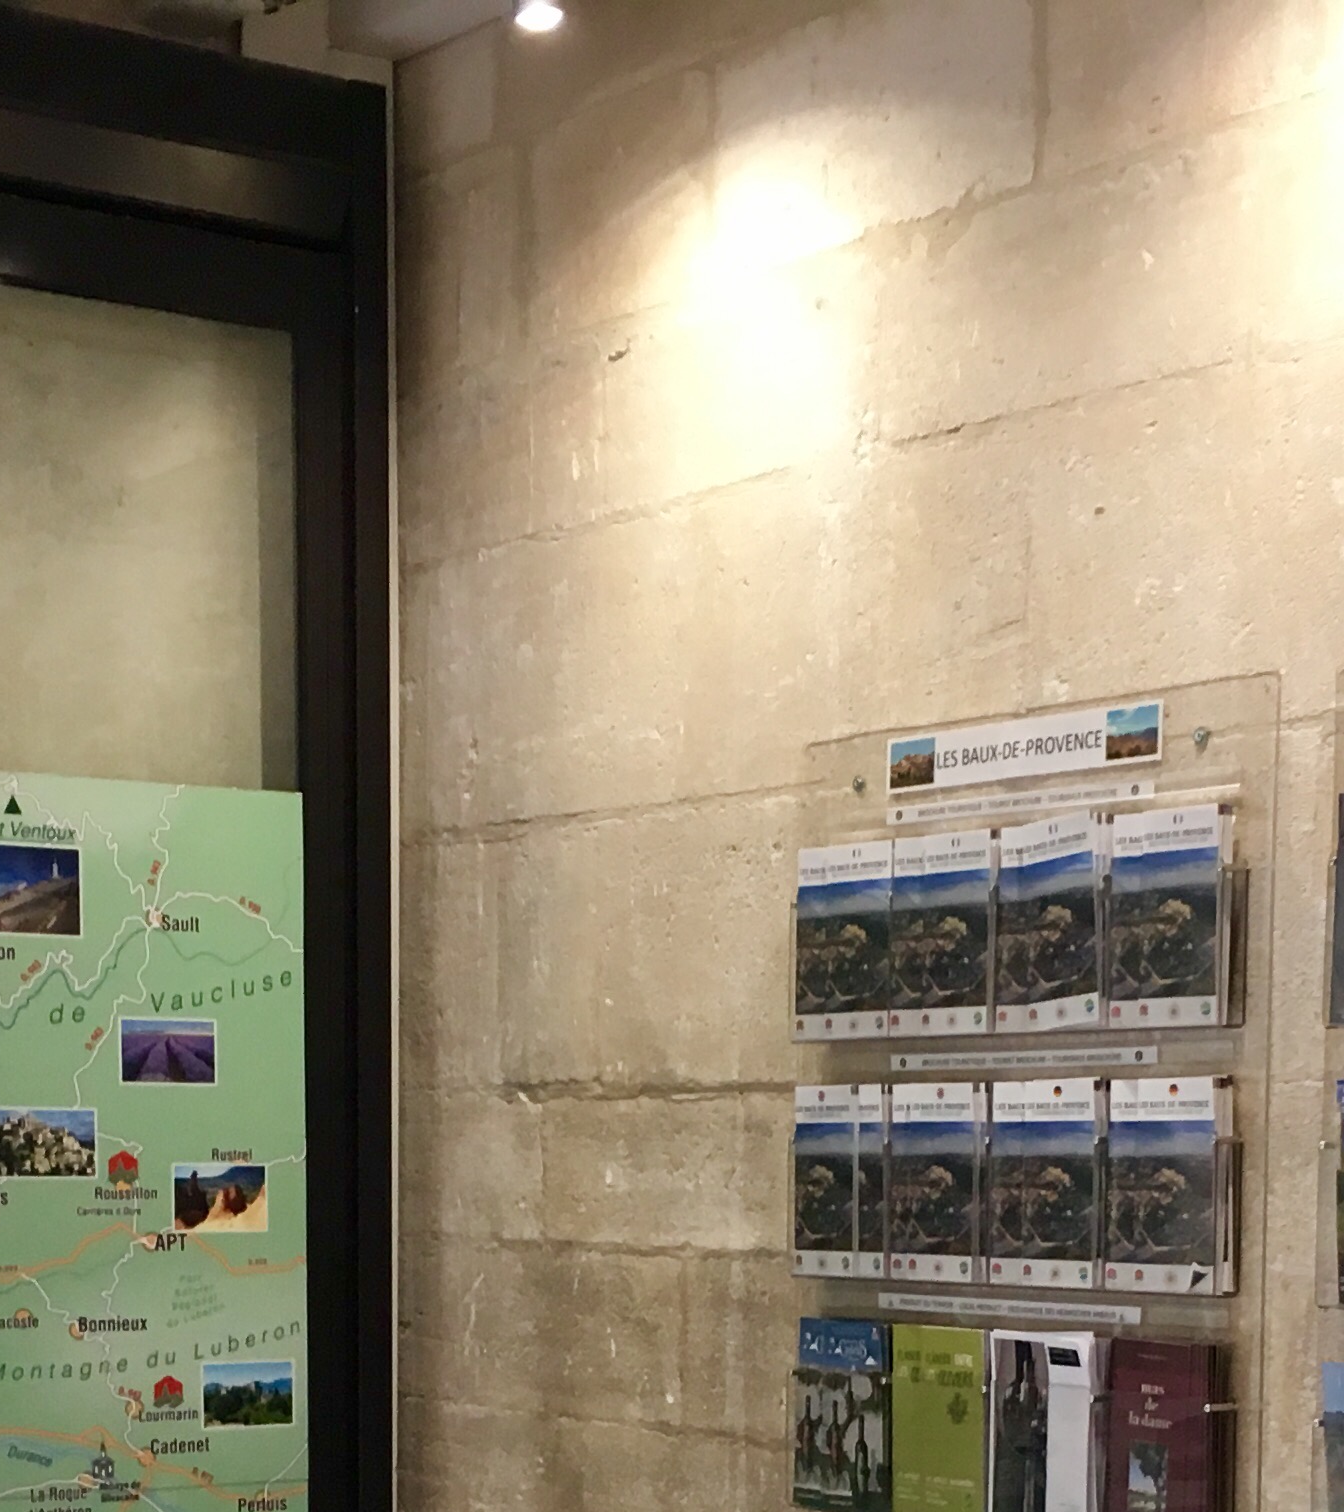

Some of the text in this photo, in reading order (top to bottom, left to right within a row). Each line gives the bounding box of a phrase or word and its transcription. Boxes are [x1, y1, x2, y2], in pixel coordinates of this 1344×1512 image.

[937, 728, 1103, 770] LES BAUX-DE-PROVENCE
[7, 820, 77, 843] Ventoux
[161, 913, 200, 935] Sault
[48, 1003, 87, 1026] de
[149, 968, 294, 1015] Vaucluse
[94, 1184, 159, 1202] Roussillon
[154, 1232, 188, 1253] APT
[77, 1316, 149, 1335] Bonnieux
[146, 1347, 177, 1370] du
[192, 1318, 302, 1361] Luberon
[137, 1406, 200, 1424] Lourmarin
[149, 1437, 211, 1457] Cadenet
[31, 1488, 46, 1503] La
